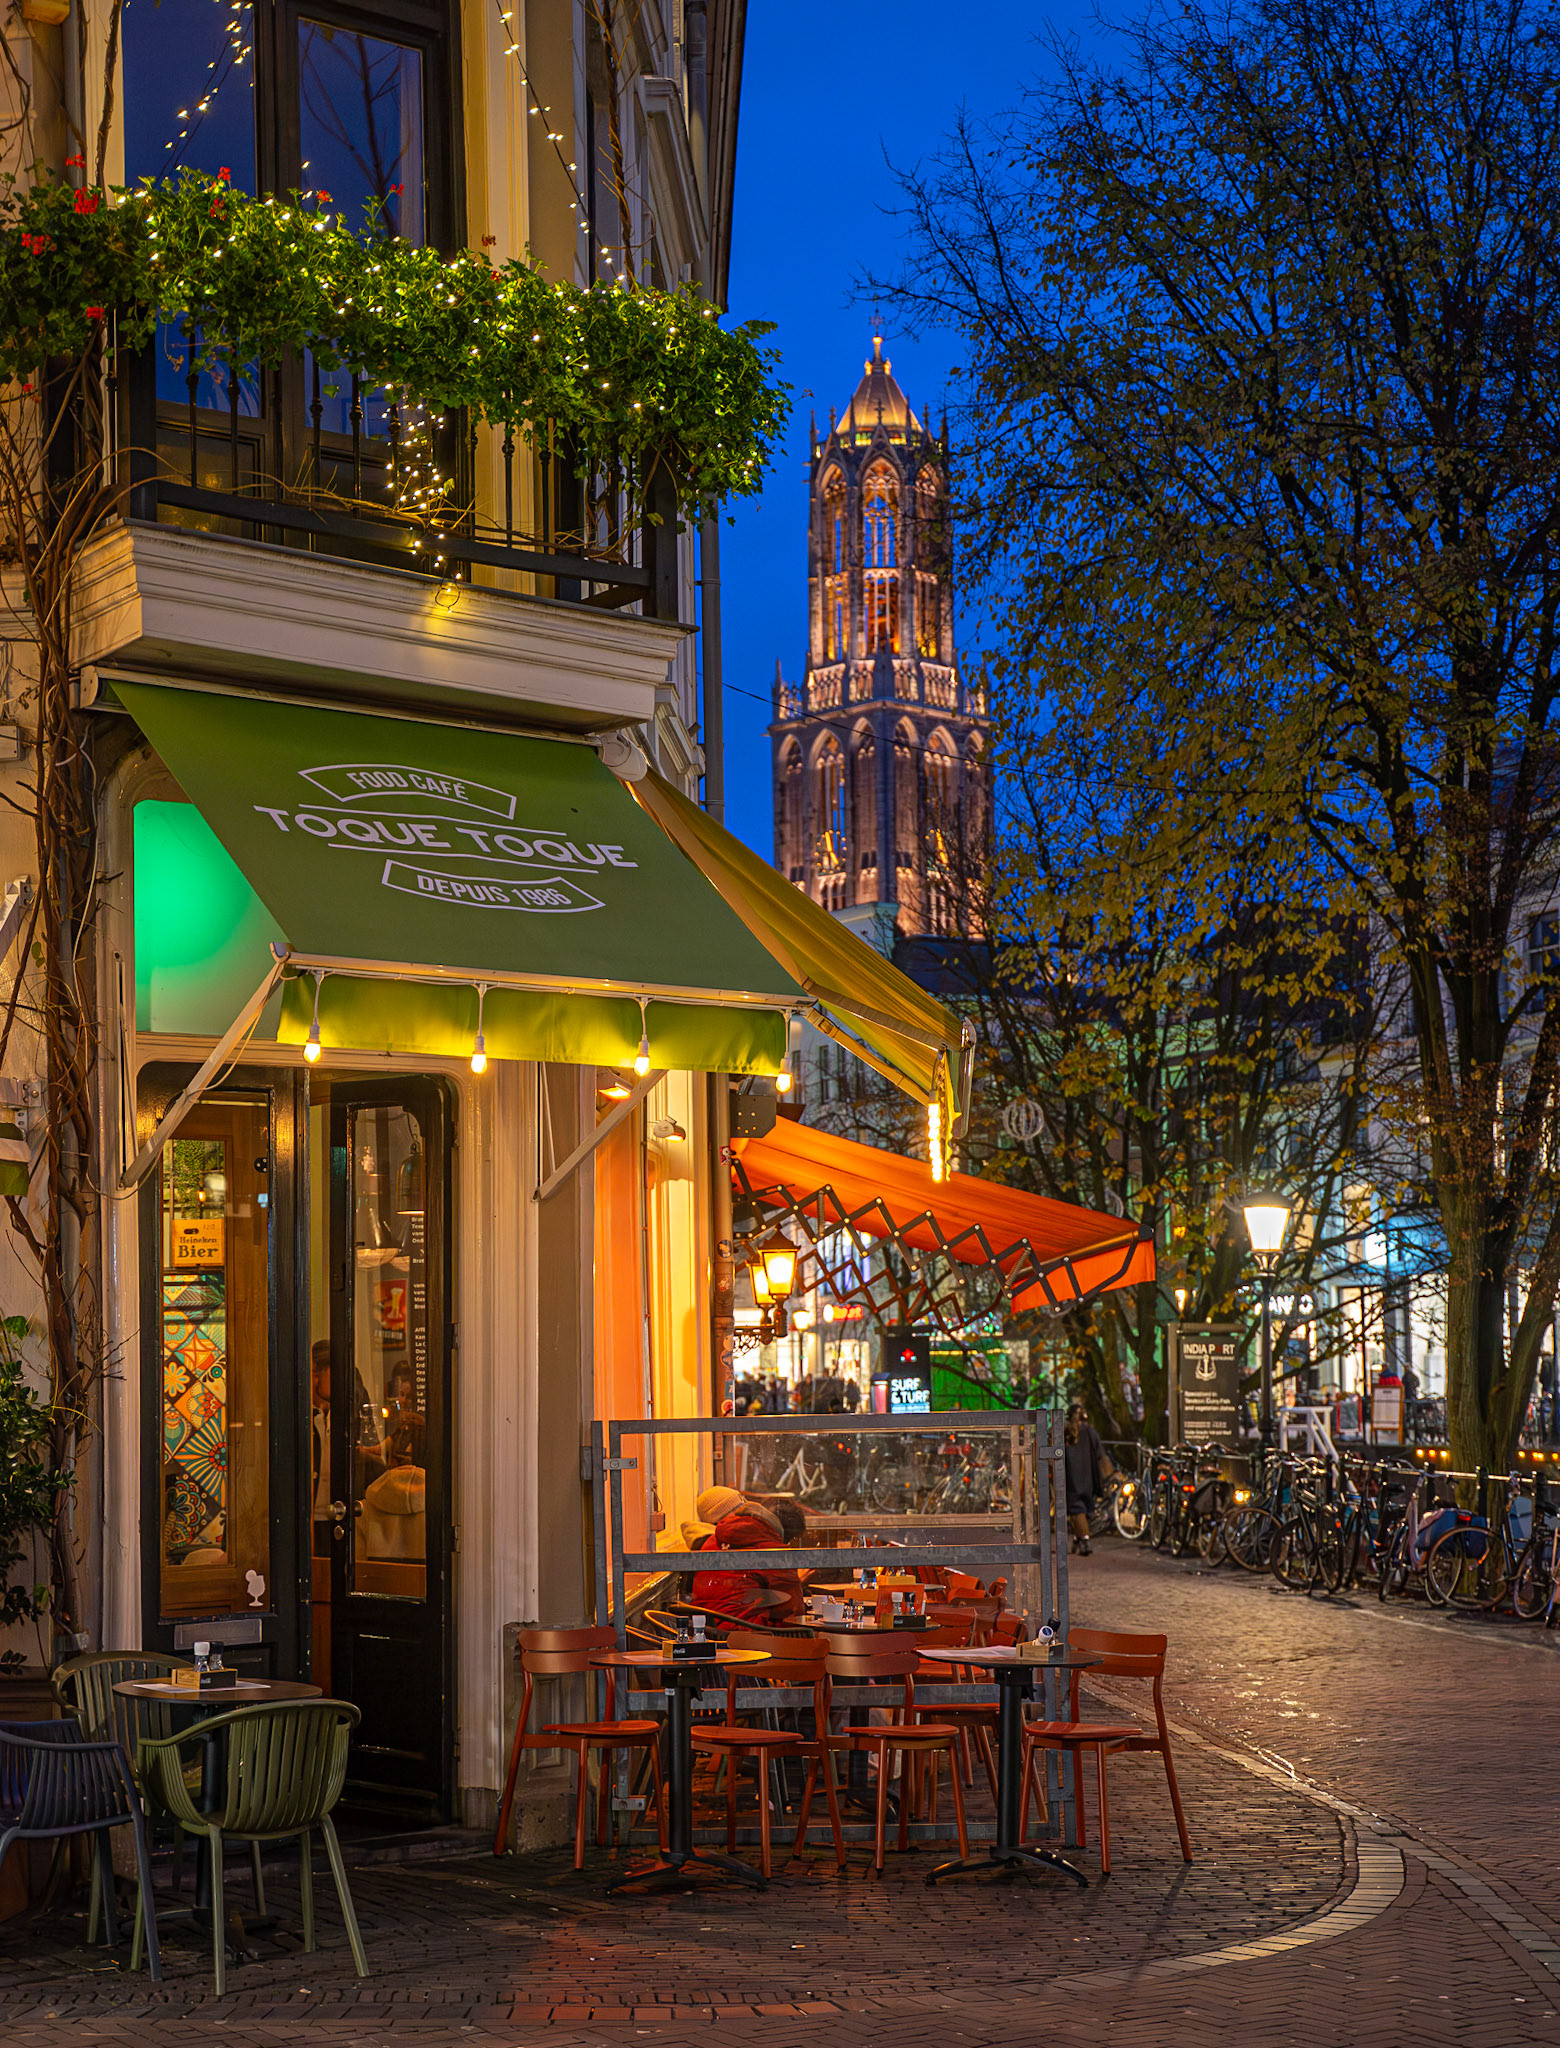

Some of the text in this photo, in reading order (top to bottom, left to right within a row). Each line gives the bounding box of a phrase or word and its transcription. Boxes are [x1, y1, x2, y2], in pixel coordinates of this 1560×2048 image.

[346, 771, 468, 800] FOOD CAFÉ
[253, 804, 639, 868] TOQUE TOQUE
[417, 875, 572, 906] DEPUIS 1986
[177, 1244, 219, 1258] Bier
[1183, 1343, 1208, 1355] INDIA
[891, 1377, 920, 1391] SURF
